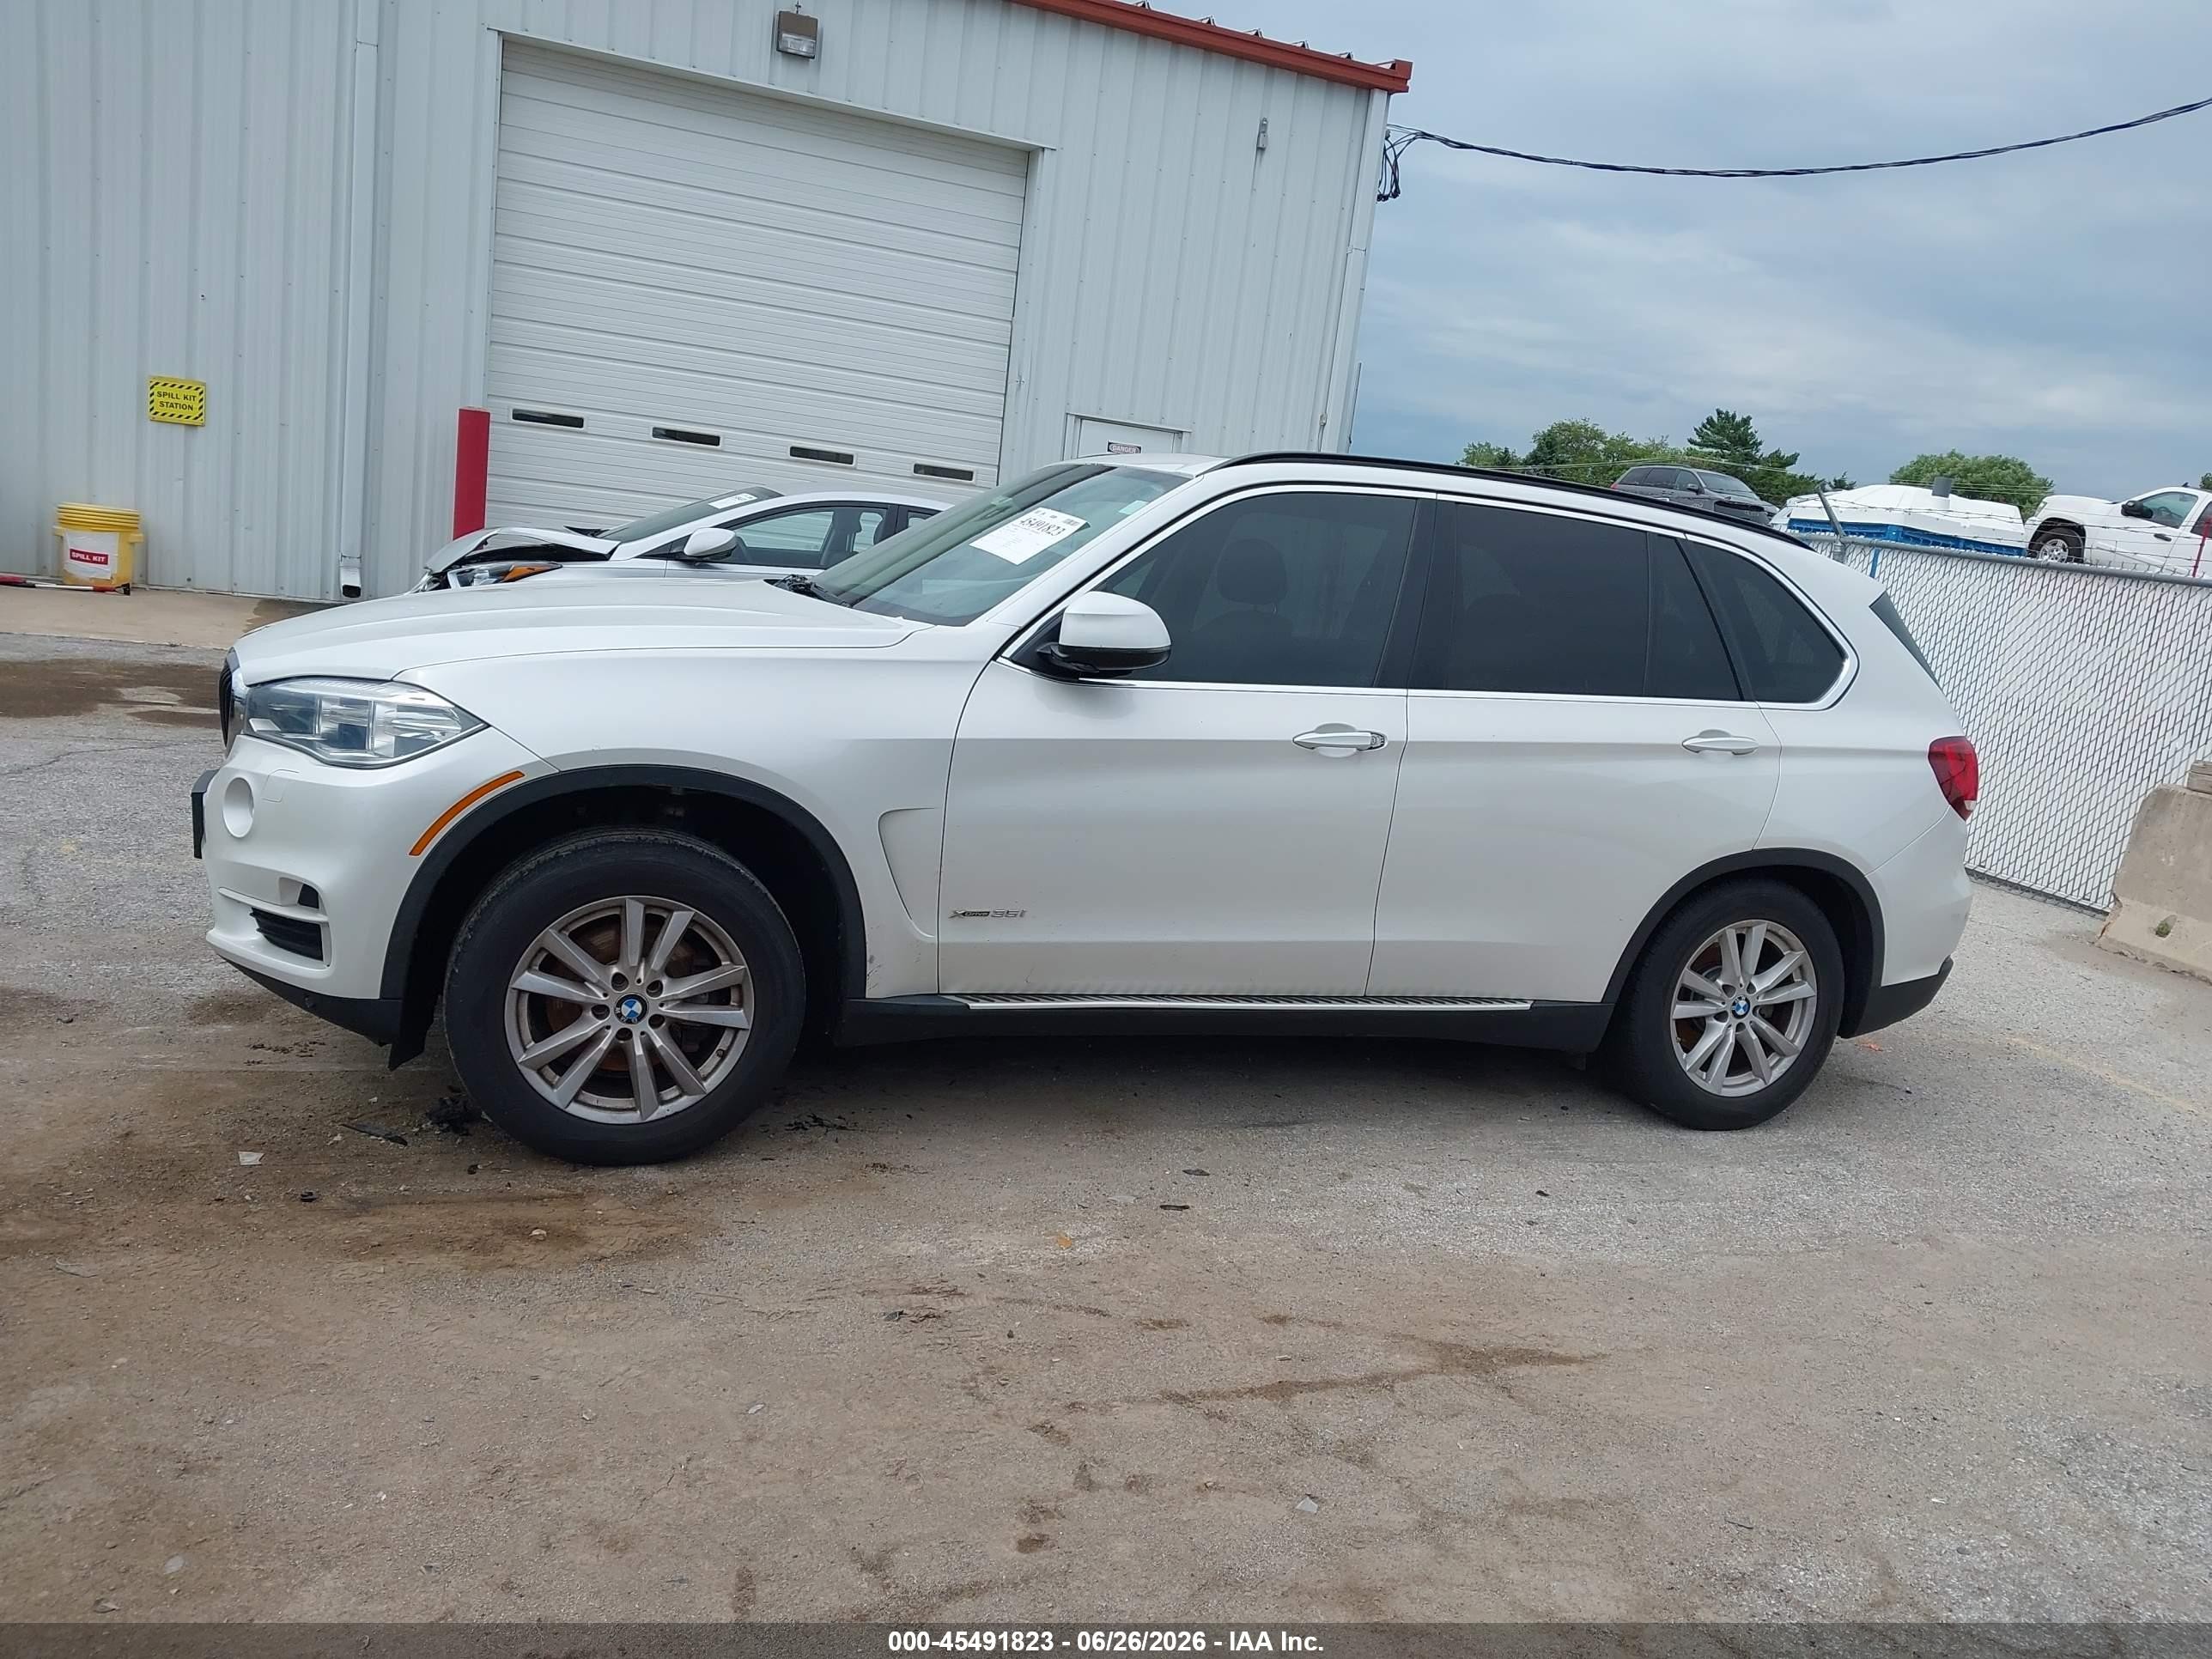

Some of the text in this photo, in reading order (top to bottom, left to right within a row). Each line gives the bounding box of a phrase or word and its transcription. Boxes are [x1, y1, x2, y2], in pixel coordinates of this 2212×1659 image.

[156, 391, 198, 402] SPILL KIT
[159, 400, 194, 411] STATION
[1112, 445, 1136, 454] DANGER
[71, 551, 91, 561] SPILL
